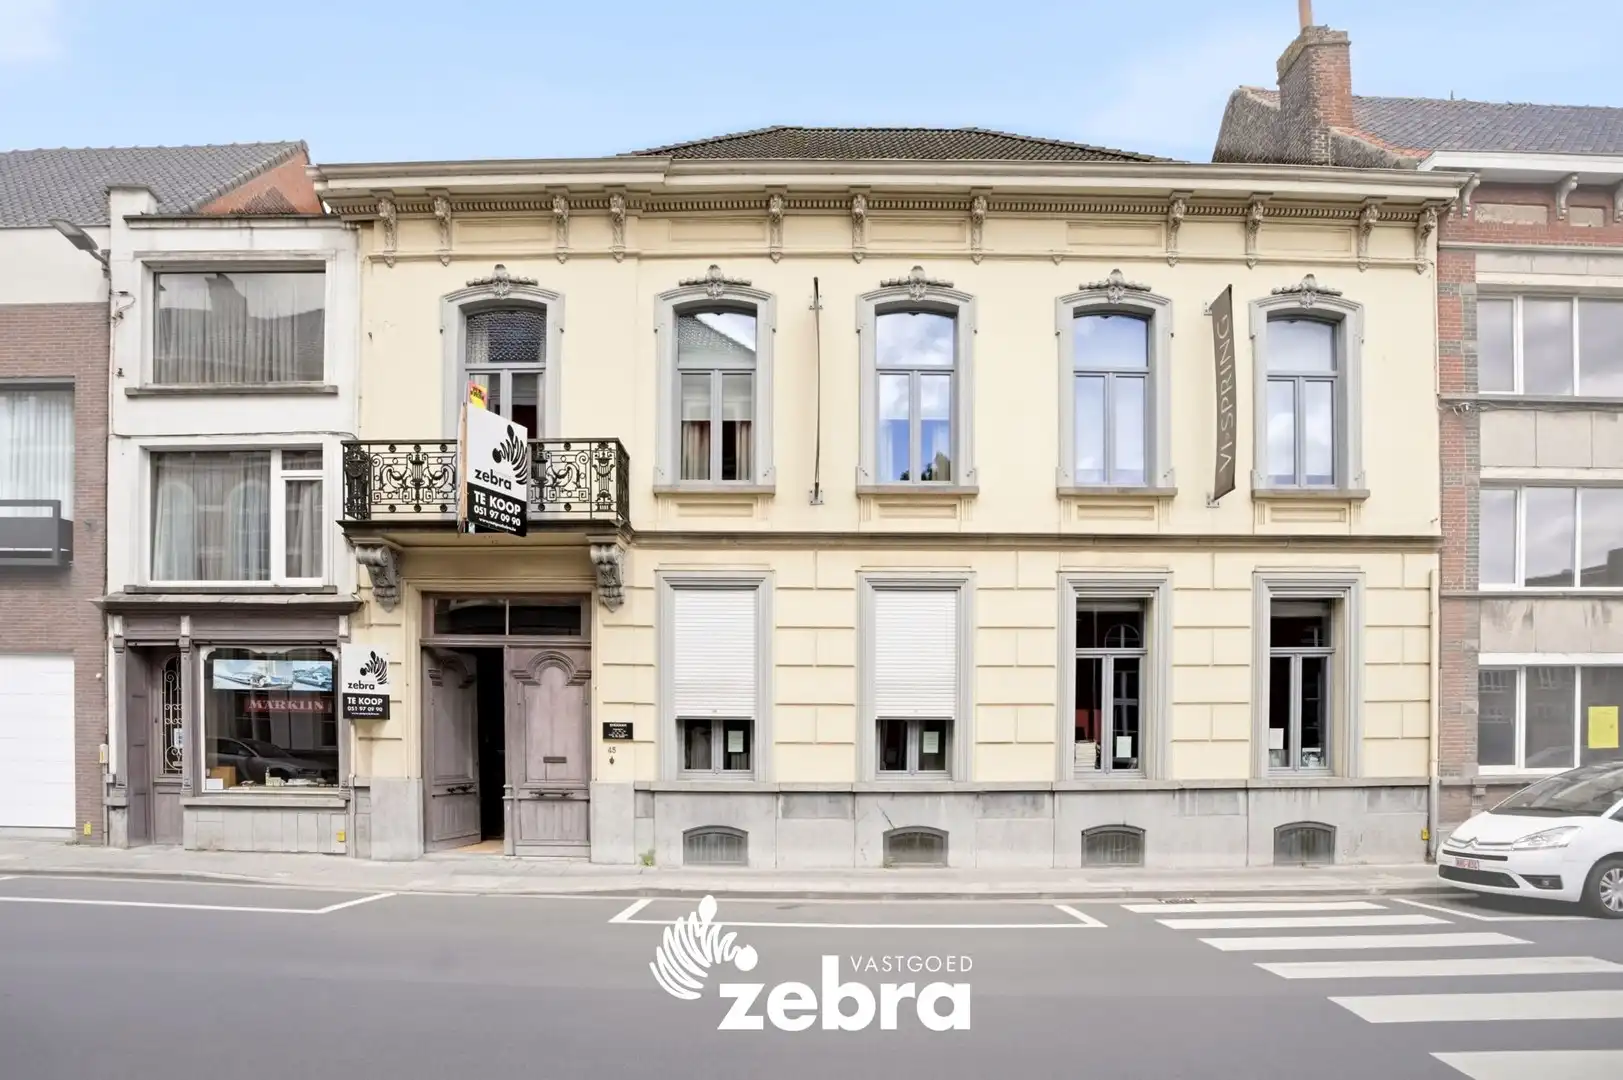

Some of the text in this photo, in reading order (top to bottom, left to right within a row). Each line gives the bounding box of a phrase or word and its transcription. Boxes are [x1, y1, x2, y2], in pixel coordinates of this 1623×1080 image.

[475, 469, 512, 490] zebra
[474, 490, 521, 515] TE KOOP
[474, 505, 487, 516] 051
[489, 510, 499, 519] 97
[500, 513, 510, 523] 09
[511, 517, 521, 526] 90
[347, 680, 375, 690] zebra
[347, 697, 383, 705] TE KOOP
